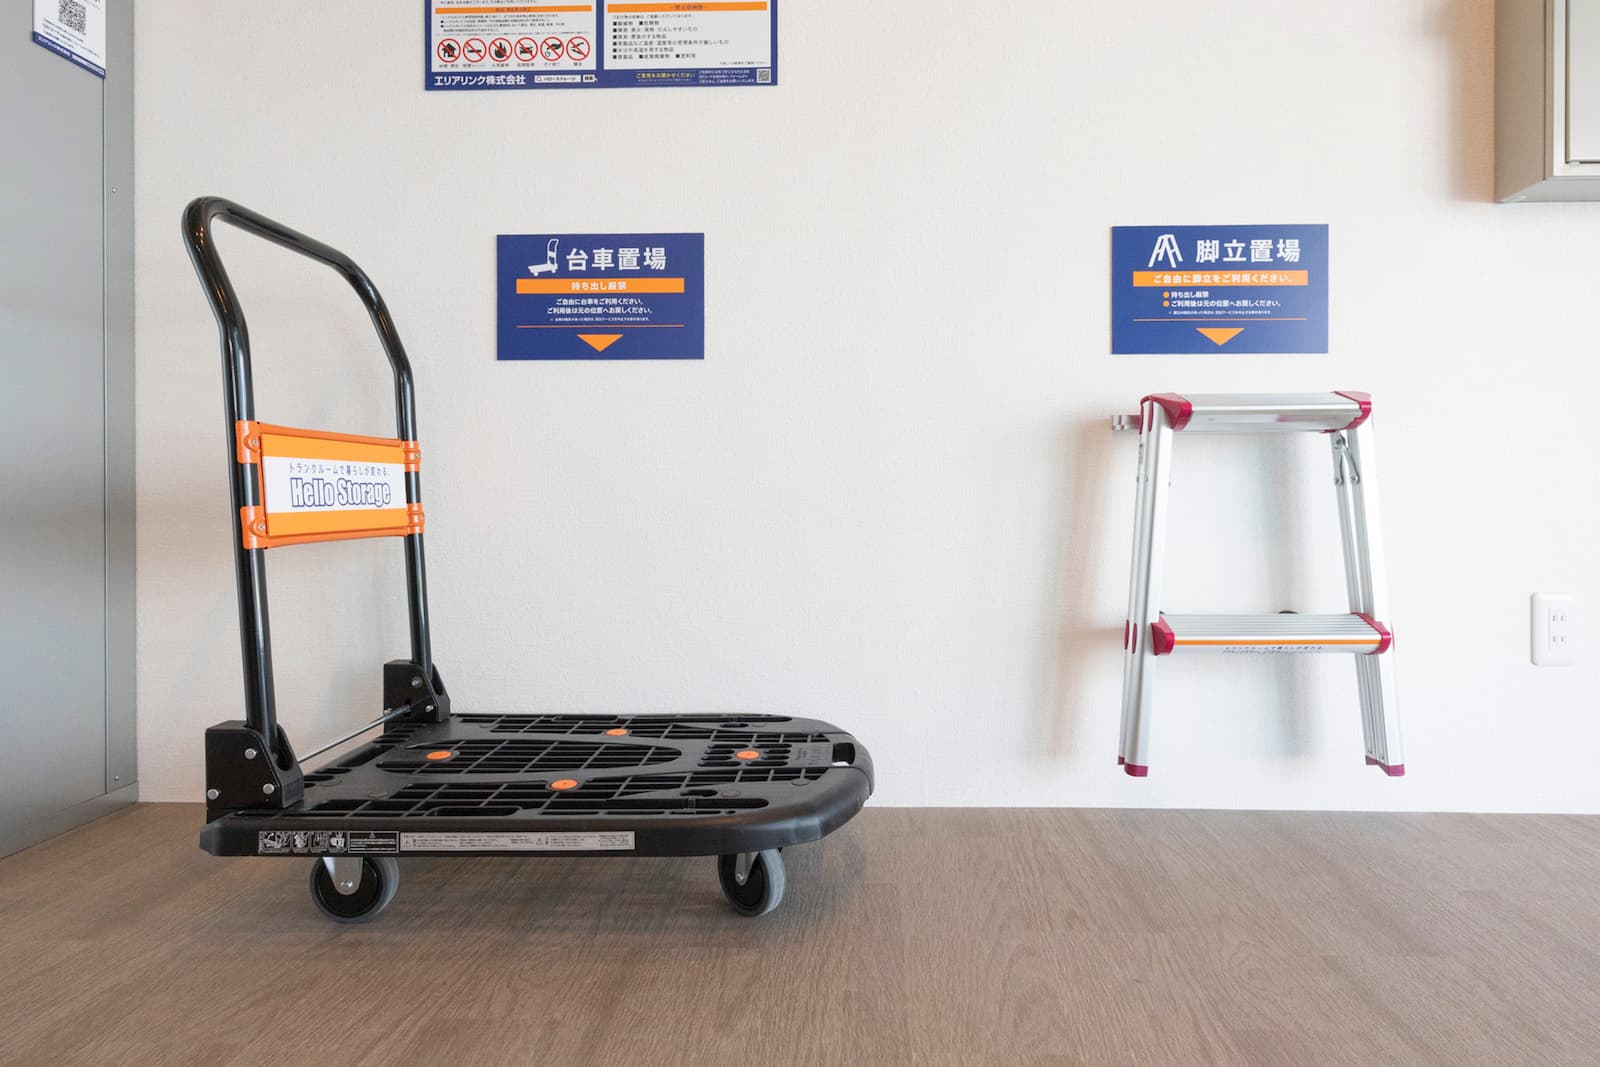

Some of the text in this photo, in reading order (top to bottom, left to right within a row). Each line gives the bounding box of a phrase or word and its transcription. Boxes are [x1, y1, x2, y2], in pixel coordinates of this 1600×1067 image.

[434, 74, 526, 86] エリアリンク株式会社
[566, 247, 667, 271] 台車置場
[1196, 239, 1301, 263] 脚立置場
[571, 281, 627, 291] 持ち出し厳禁
[1153, 274, 1293, 284] ご自由に脚立をご利用ください。
[290, 477, 391, 508] Hello Storage
